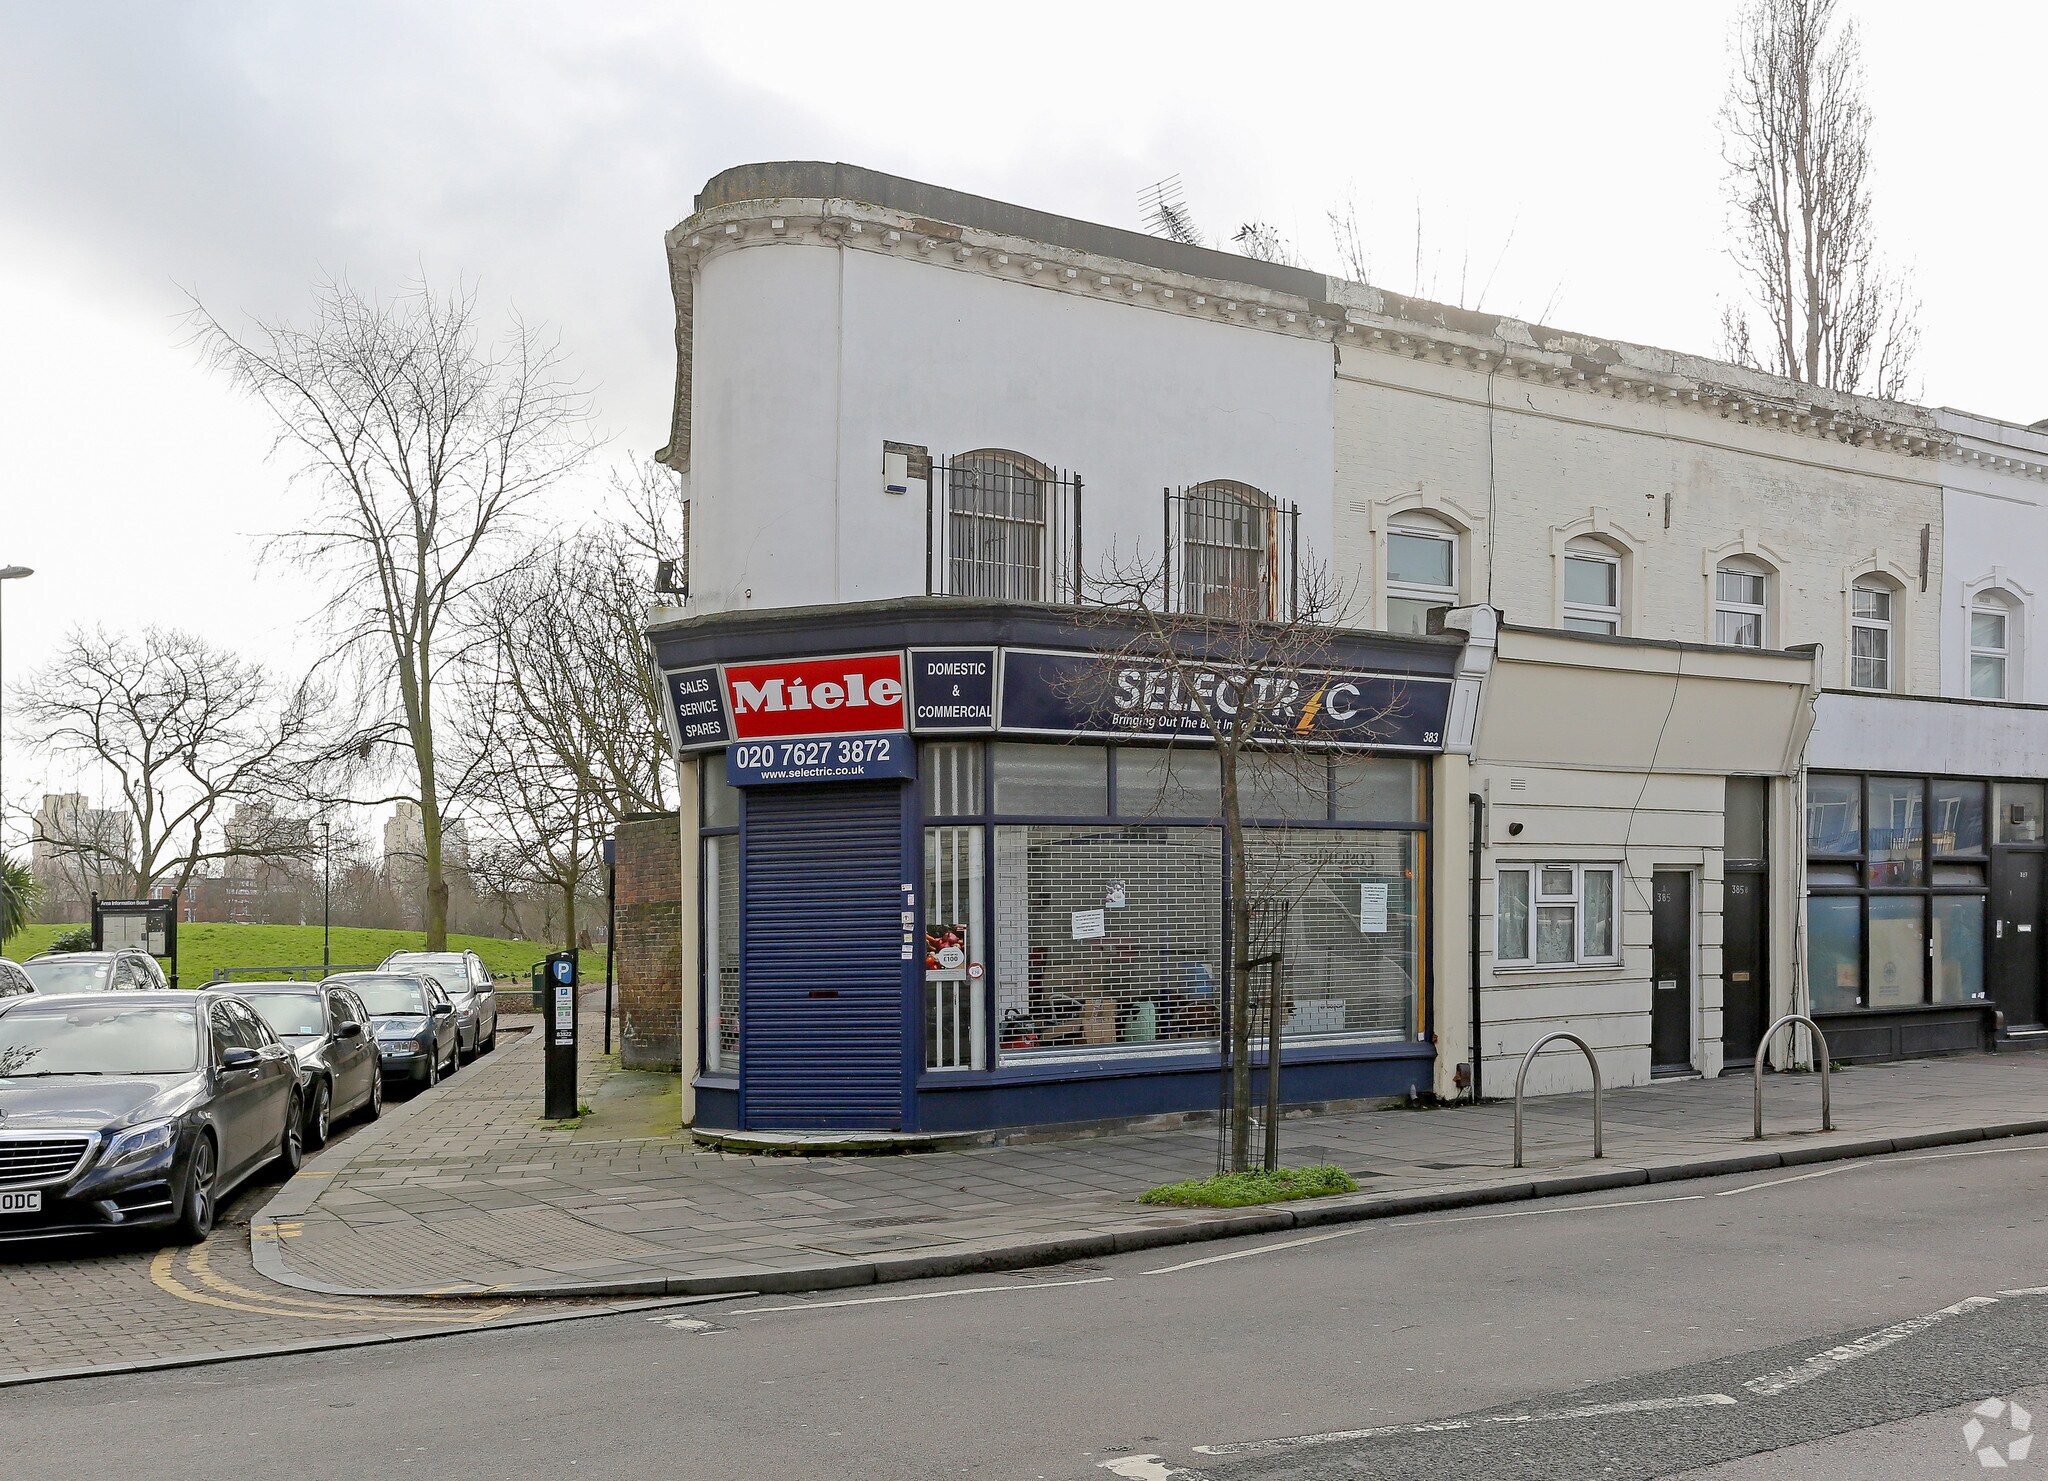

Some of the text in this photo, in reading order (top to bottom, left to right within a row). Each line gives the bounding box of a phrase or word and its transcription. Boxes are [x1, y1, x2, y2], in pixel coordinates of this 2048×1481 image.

[927, 662, 986, 675] DOMESTIC
[679, 678, 709, 695] SALES
[732, 673, 902, 714] Miele
[952, 684, 960, 697] &
[680, 699, 718, 717] SERVICE
[917, 705, 992, 718] COMMERCIAL
[685, 720, 721, 738] SPARES
[1112, 713, 1155, 727] Bringing
[1158, 715, 1177, 728] Out
[1180, 716, 1198, 729] The
[1200, 718, 1221, 730] Bet
[1223, 719, 1233, 730] In
[1423, 731, 1439, 744] 383
[736, 739, 890, 769] 020 7627 3872
[761, 765, 865, 779] www.selectric.co.uk
[1656, 892, 1671, 902] 385
[557, 963, 570, 979] P
[3, 1193, 37, 1210] ODC
